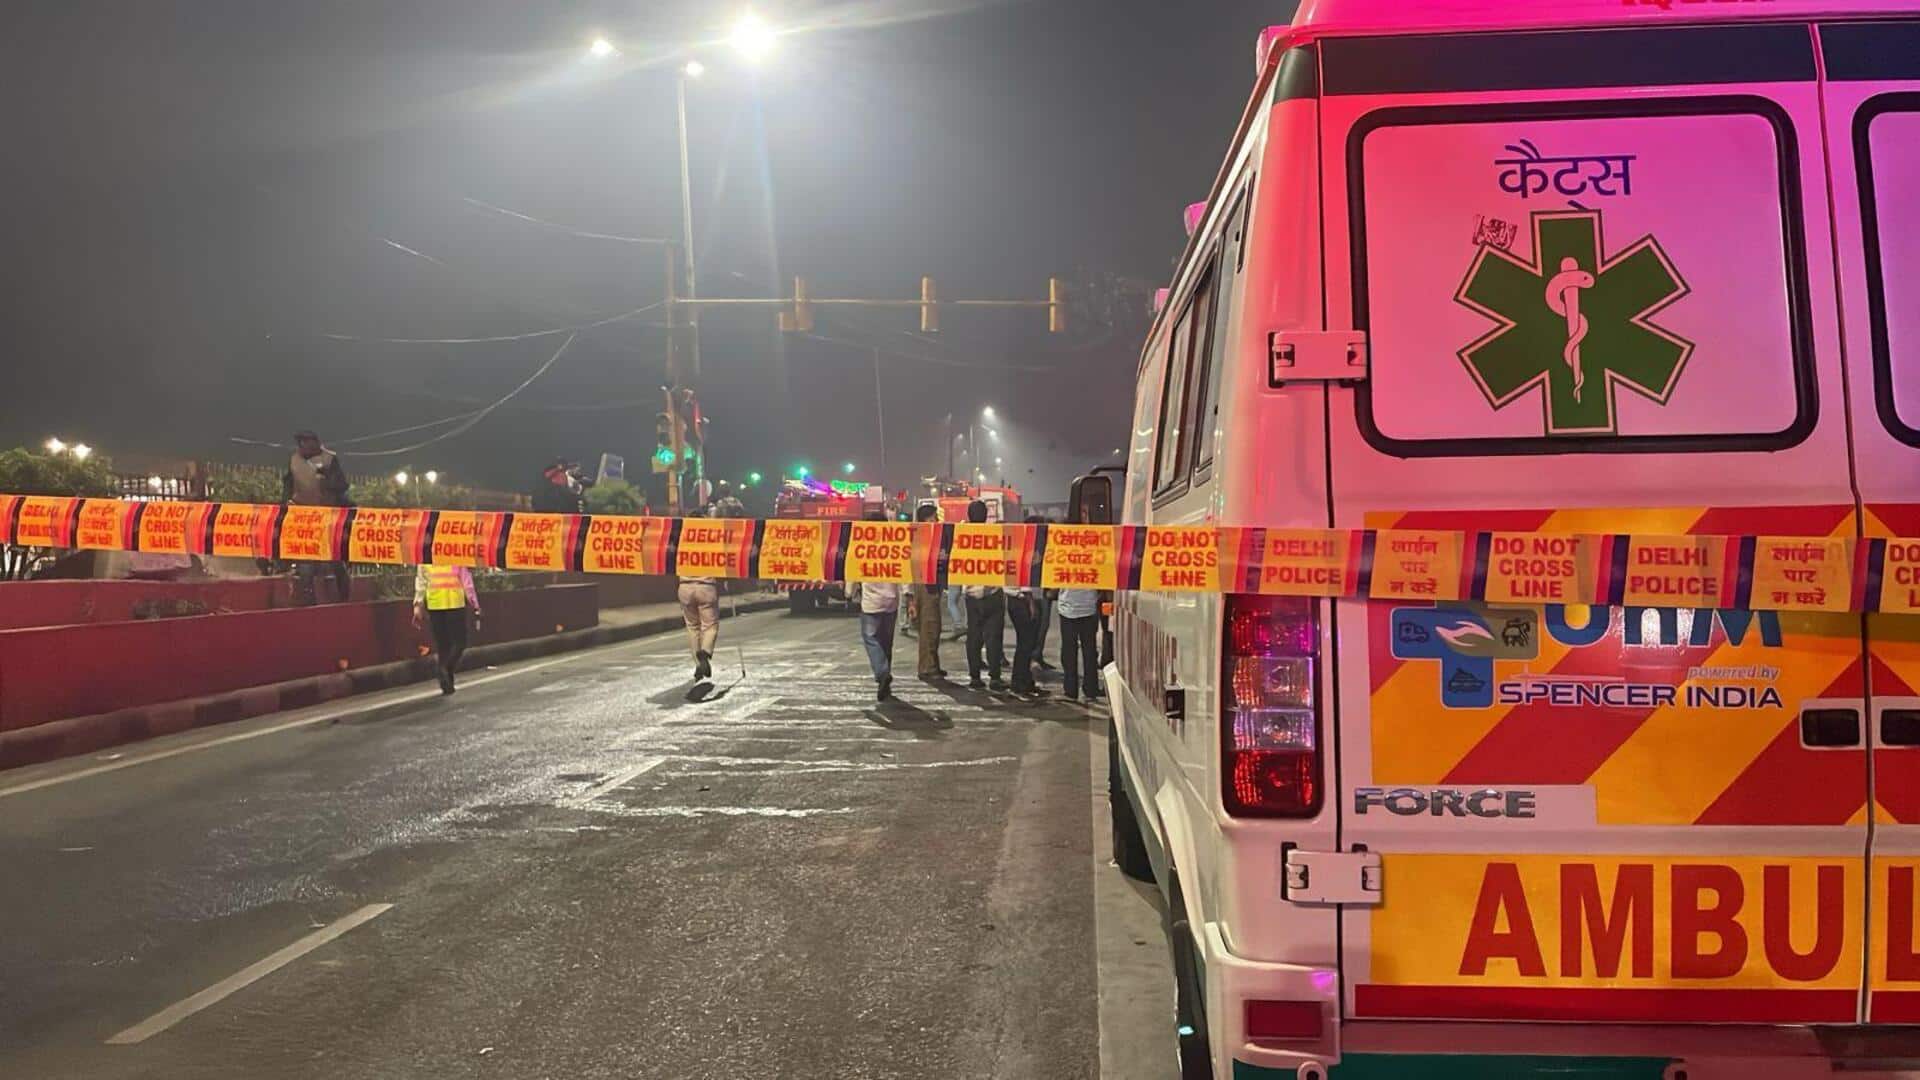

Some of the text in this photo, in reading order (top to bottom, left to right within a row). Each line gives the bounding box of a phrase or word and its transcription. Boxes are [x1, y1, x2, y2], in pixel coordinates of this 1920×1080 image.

[145, 505, 193, 519] DO NOT
[221, 512, 259, 526] DELHI
[356, 513, 410, 527] DO NOT
[146, 519, 186, 533] CROSS
[440, 520, 484, 536] DELHI
[591, 521, 650, 537] DO NOT
[151, 536, 179, 549] LINE
[357, 528, 402, 543] CROSS
[686, 528, 734, 544] DELHI
[853, 527, 918, 543] DO NOT
[958, 534, 1012, 551] DELHI
[1148, 531, 1221, 548] DO NOT
[362, 545, 396, 560] LINE
[435, 543, 485, 558] POLICE
[592, 537, 643, 553] CROSS
[855, 545, 912, 560] CROSS
[1273, 539, 1335, 557] DELHI
[1494, 538, 1581, 556] DO NOT
[679, 551, 737, 568] POLICE
[1152, 551, 1217, 567] CROSS
[1638, 547, 1708, 567] DELHI
[1889, 544, 1920, 563] DO
[598, 555, 635, 570] LINE
[861, 563, 902, 578] LINE
[951, 558, 1017, 575] POLICE
[1500, 559, 1574, 577] CROSS
[1160, 570, 1206, 587] LINE
[1265, 566, 1342, 585] POLICE
[1784, 569, 1817, 583] पार
[1510, 579, 1563, 598] LINE
[1631, 576, 1717, 596] POLICE
[1686, 666, 1780, 682] powered by
[1498, 682, 1783, 708] SPENCER INDIA
[1354, 787, 1536, 818] FORCE
